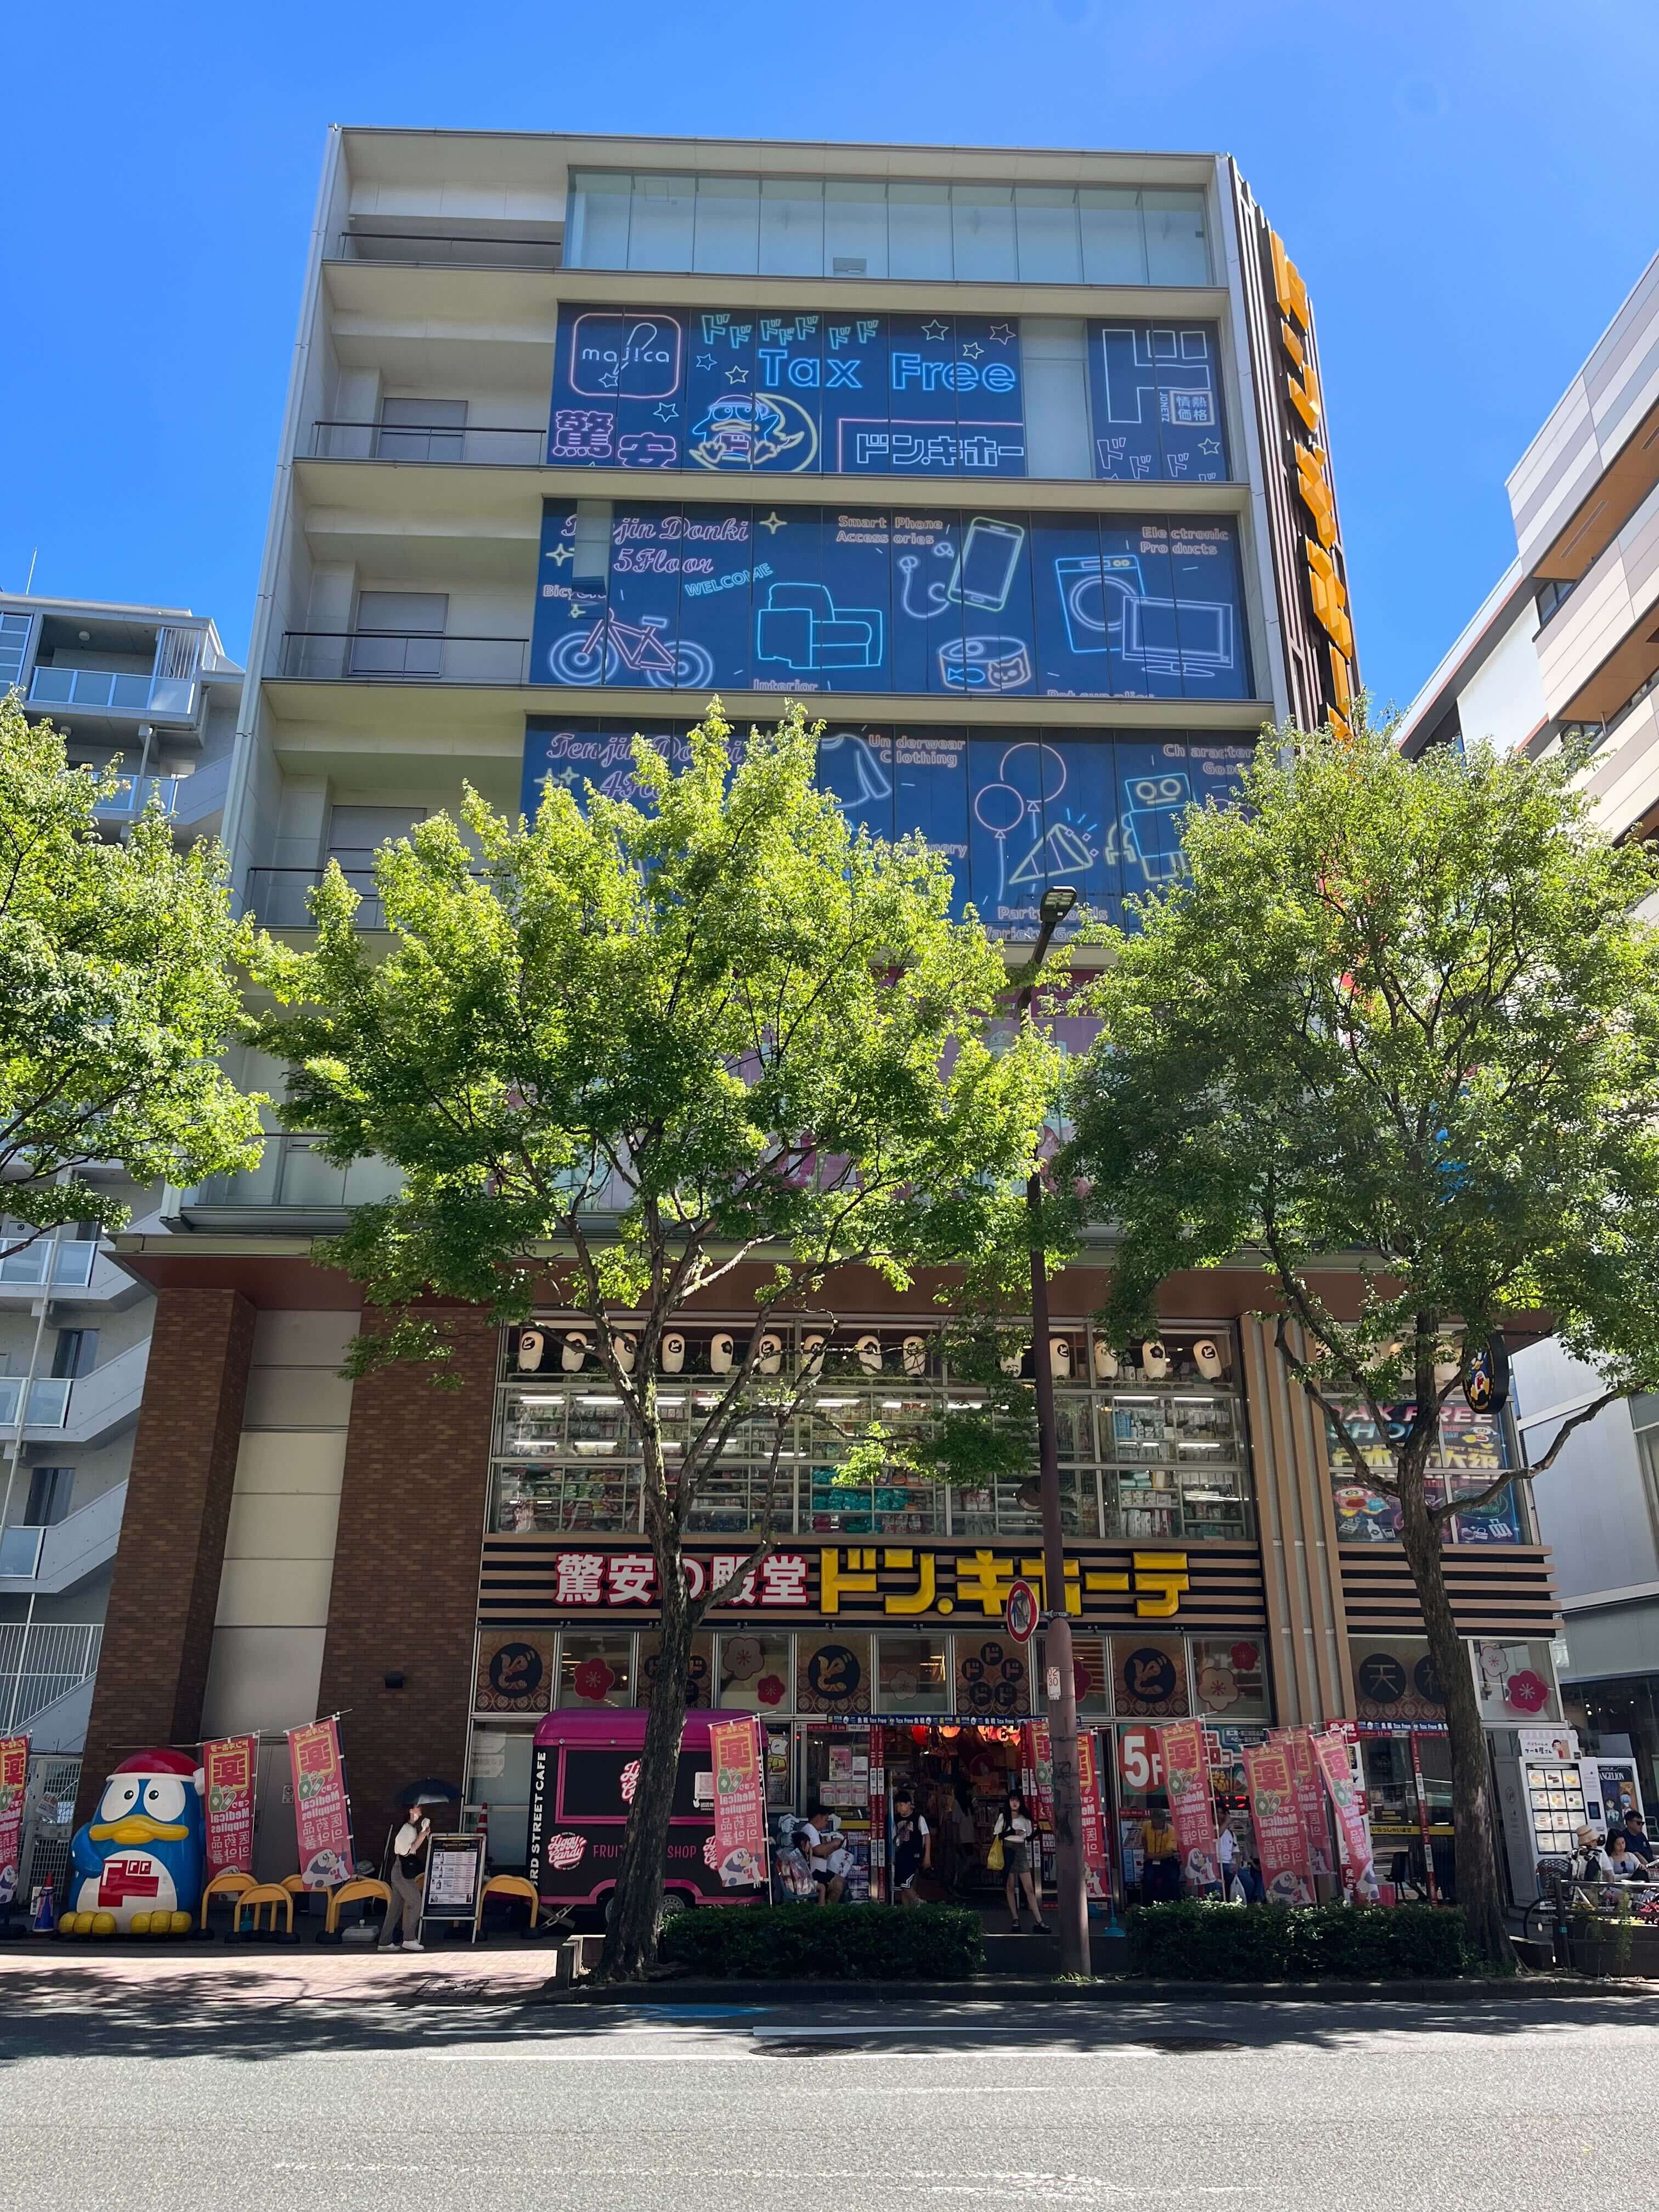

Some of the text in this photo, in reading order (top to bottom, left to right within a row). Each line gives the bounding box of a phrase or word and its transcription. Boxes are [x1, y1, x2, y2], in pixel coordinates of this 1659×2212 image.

[759, 349, 1017, 392] Tax Free
[1159, 393, 1169, 422] JONETZ
[659, 516, 749, 541] Donki
[837, 515, 944, 531] Smart Phone
[685, 562, 773, 597] WELCOME
[753, 679, 819, 691] Interior
[546, 733, 636, 768] Tenji
[1328, 1422, 1414, 1439] SHO
[535, 1752, 546, 1791] CAFE
[531, 1793, 543, 1854] STREET
[592, 1844, 697, 1859] FRUI SHOP
